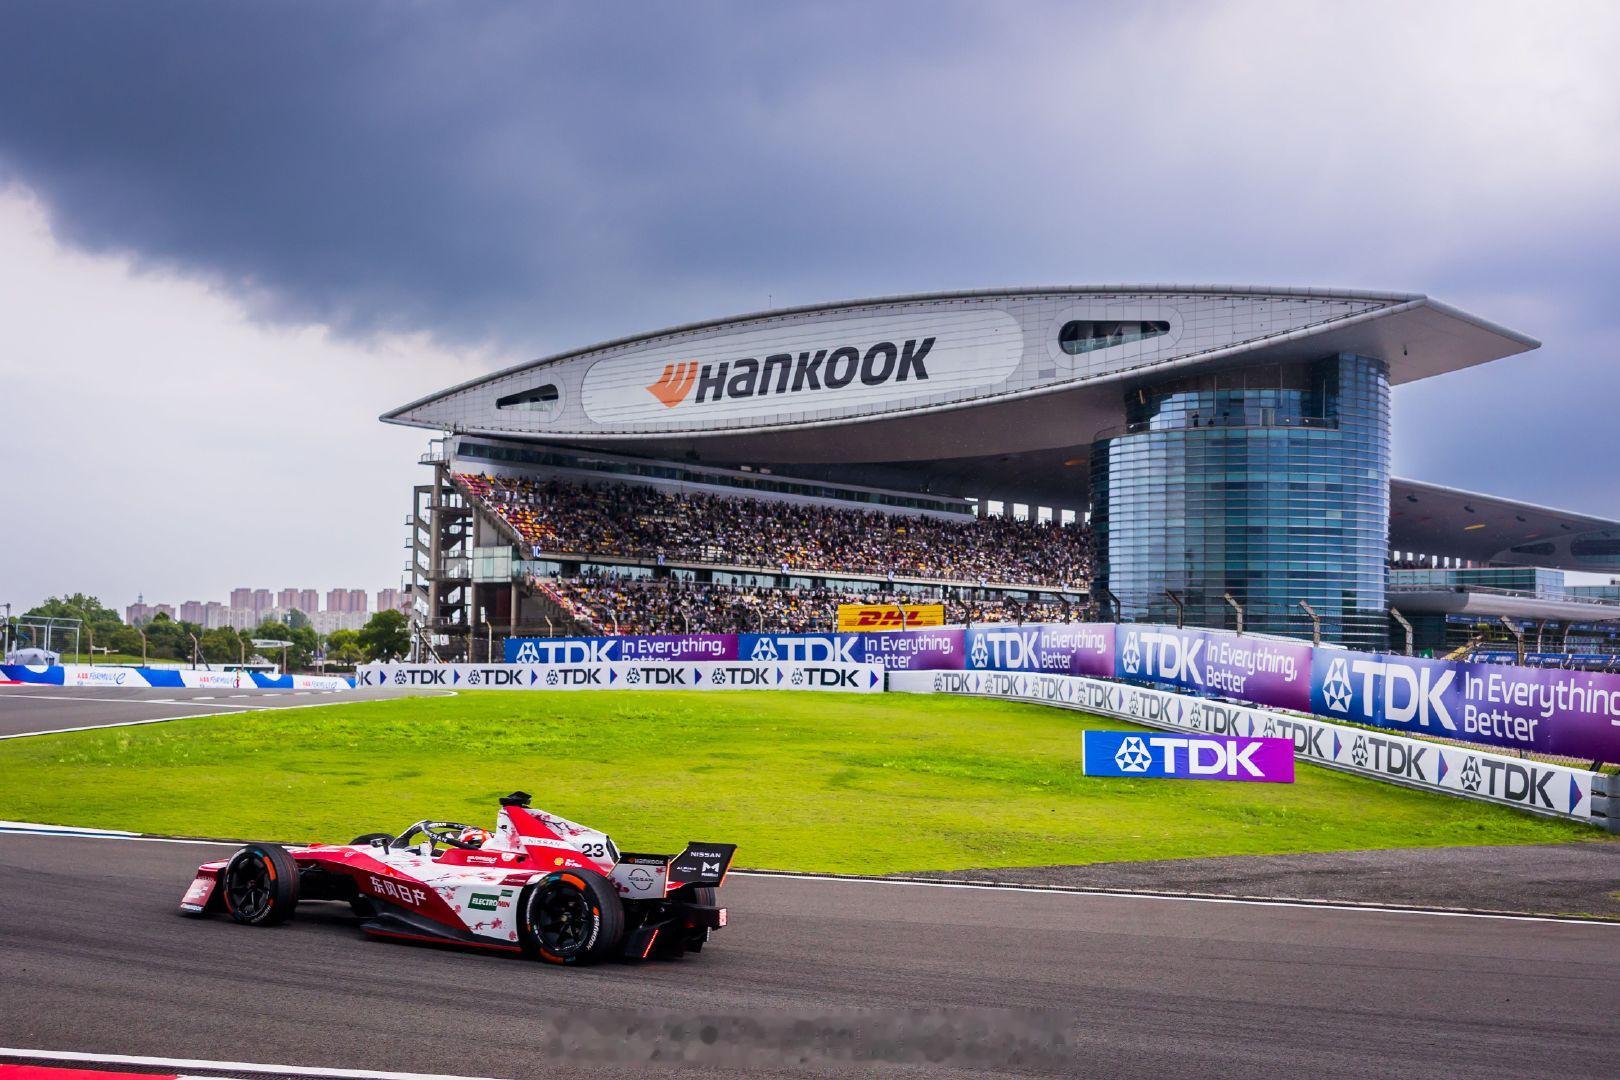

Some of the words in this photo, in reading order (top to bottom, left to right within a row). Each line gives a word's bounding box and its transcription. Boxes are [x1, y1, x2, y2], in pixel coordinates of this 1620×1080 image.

[857, 611, 923, 625] DHL
[539, 640, 617, 663] TDK
[621, 639, 635, 654] In
[638, 637, 726, 657] Everything,
[777, 637, 859, 663] TDK
[864, 636, 877, 651] In
[881, 635, 954, 655] Everything,
[987, 631, 1039, 669] TDK
[1041, 632, 1050, 648] In
[1051, 630, 1106, 654] Everything,
[865, 653, 911, 669] Better
[1041, 651, 1071, 669] Better
[1140, 632, 1204, 685] TDK
[1207, 641, 1219, 660] In
[1219, 643, 1298, 682] Everything,
[407, 670, 447, 685] TDK
[480, 669, 523, 685] TDK
[558, 668, 602, 685] TDK
[640, 668, 686, 685] TDK
[725, 668, 769, 684] TDK
[811, 668, 859, 687] TDK
[942, 673, 970, 693] TDK
[992, 674, 1020, 695] TDK
[1206, 665, 1246, 693] Better
[1465, 671, 1483, 700] In
[1039, 677, 1065, 701] TDK
[1086, 683, 1114, 710] TDK
[1352, 660, 1457, 731] TDK
[1138, 692, 1172, 722] TDK
[1201, 704, 1240, 737] TDK
[1464, 704, 1539, 742] Better
[1277, 720, 1325, 758] TDK
[1149, 737, 1265, 777] TDK
[1368, 737, 1427, 781] TDK
[1481, 761, 1556, 809] TDK
[528, 838, 561, 847] NISSAN
[582, 843, 604, 858] 23
[370, 875, 427, 906] 东风日产
[471, 897, 510, 908] ELECTROMIN
